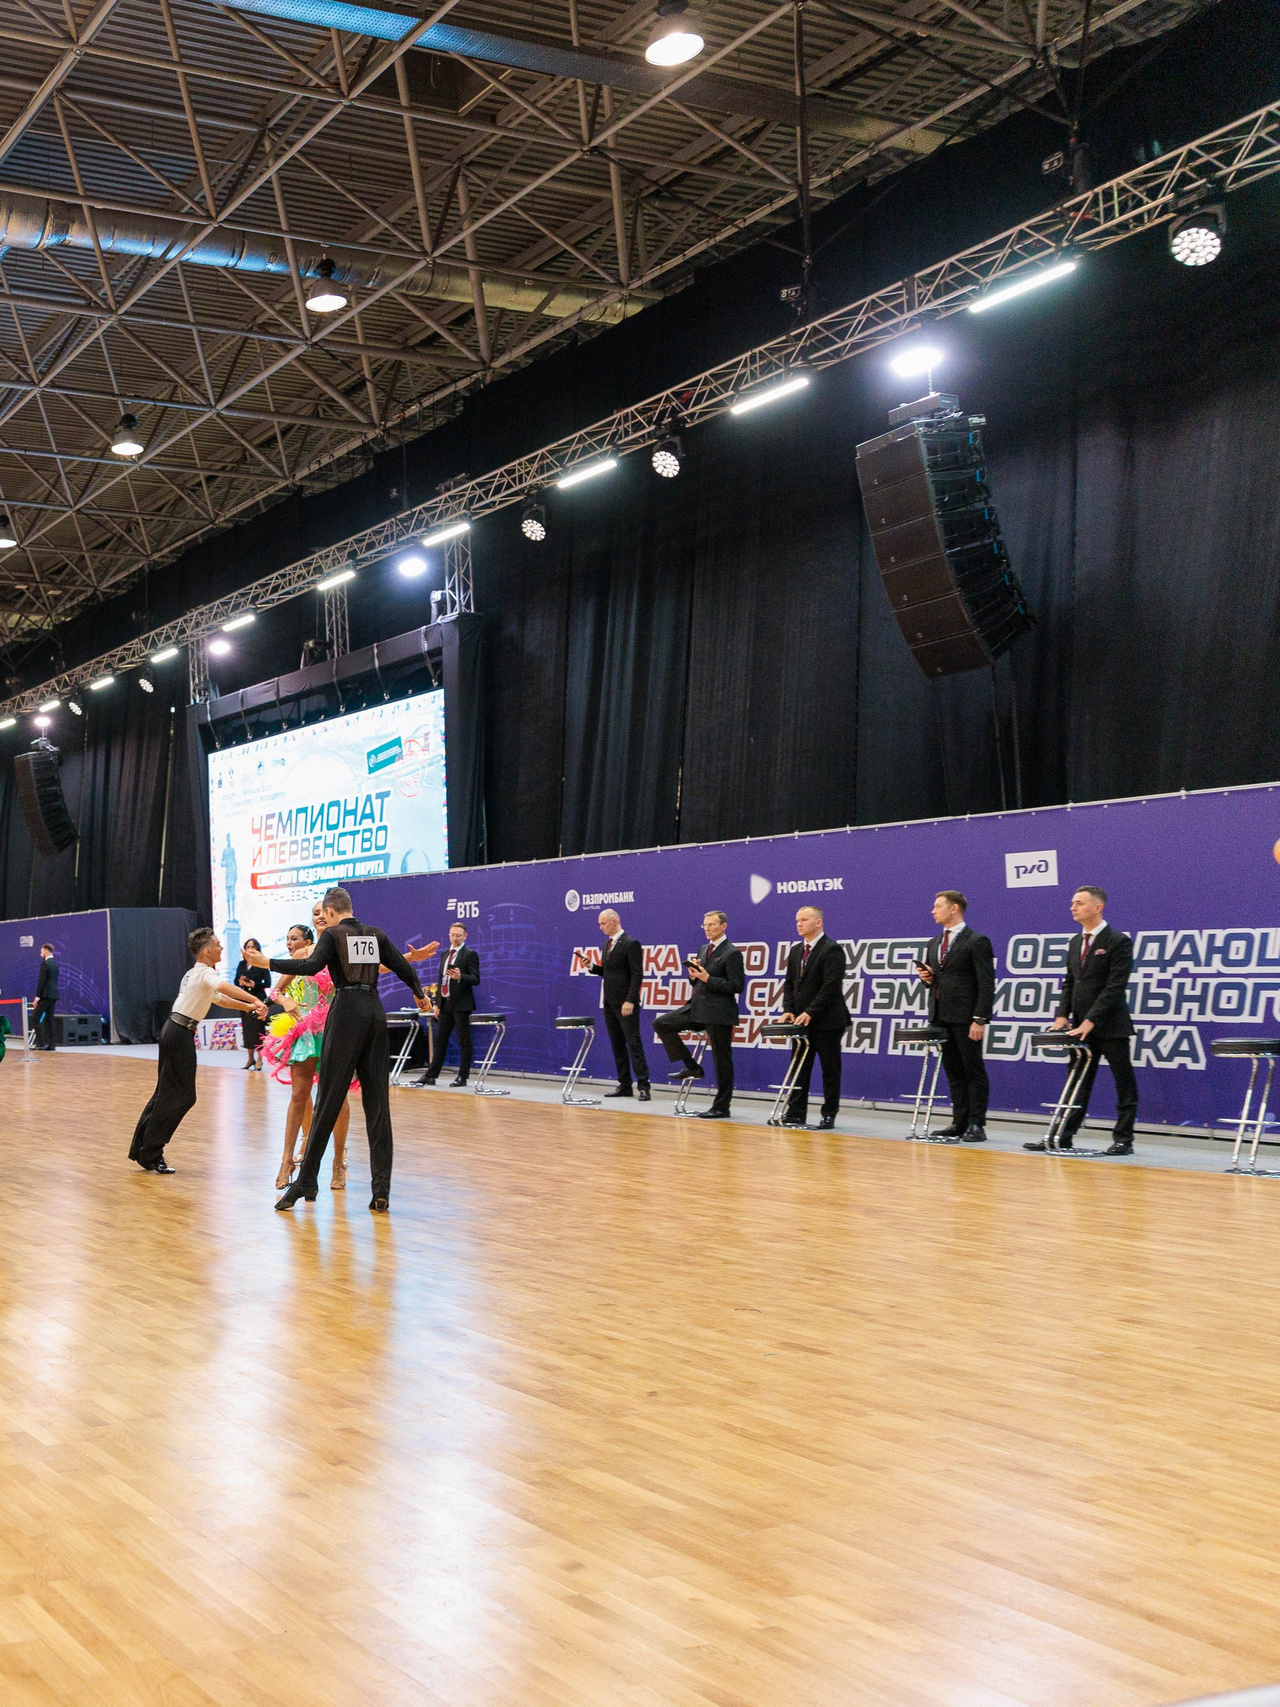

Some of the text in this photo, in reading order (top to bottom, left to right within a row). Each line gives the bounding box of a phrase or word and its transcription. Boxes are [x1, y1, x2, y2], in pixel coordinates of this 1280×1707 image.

[251, 789, 391, 842] ЧЕМПИОНАТ
[252, 825, 388, 867] И ПЕРВЕНСТВО
[354, 860, 385, 878] ОКРУГА
[776, 878, 844, 894] НОВАТЭК
[582, 891, 635, 906] ГАЗПРОМБАНК
[457, 900, 480, 919] ВТБ
[353, 941, 375, 956] 176
